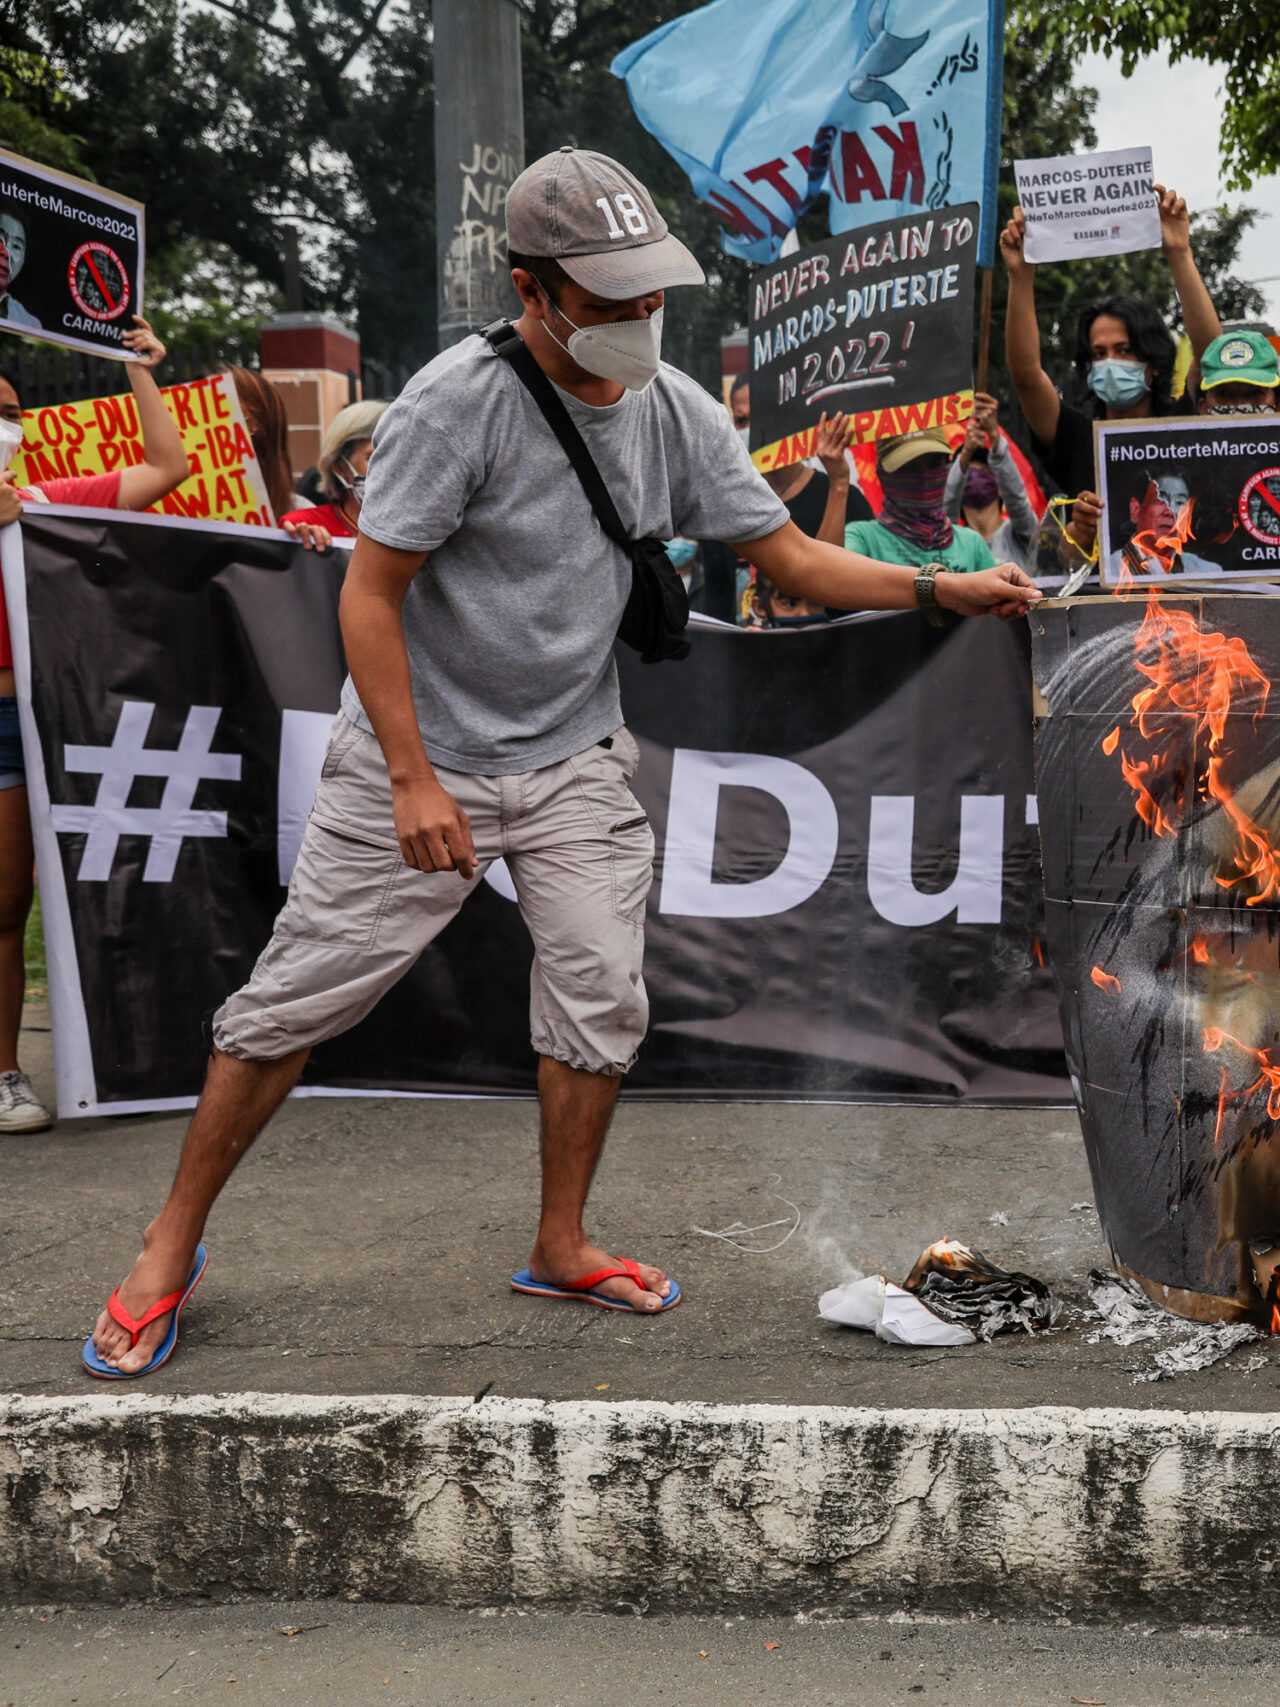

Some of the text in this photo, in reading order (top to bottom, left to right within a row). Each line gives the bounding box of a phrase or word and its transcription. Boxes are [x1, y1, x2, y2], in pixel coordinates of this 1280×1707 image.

[461, 174, 510, 217] NP
[1019, 161, 1152, 188] MARCOS-DUTERTE
[1021, 178, 1154, 208] NEVER AGAIN
[1, 181, 136, 241] uterteMarcos2022
[596, 193, 648, 240] 18
[754, 217, 973, 321] NEVER AGAIN TO
[754, 264, 960, 371] MARCOS-DUTERTE
[778, 321, 915, 406] IN 2022!
